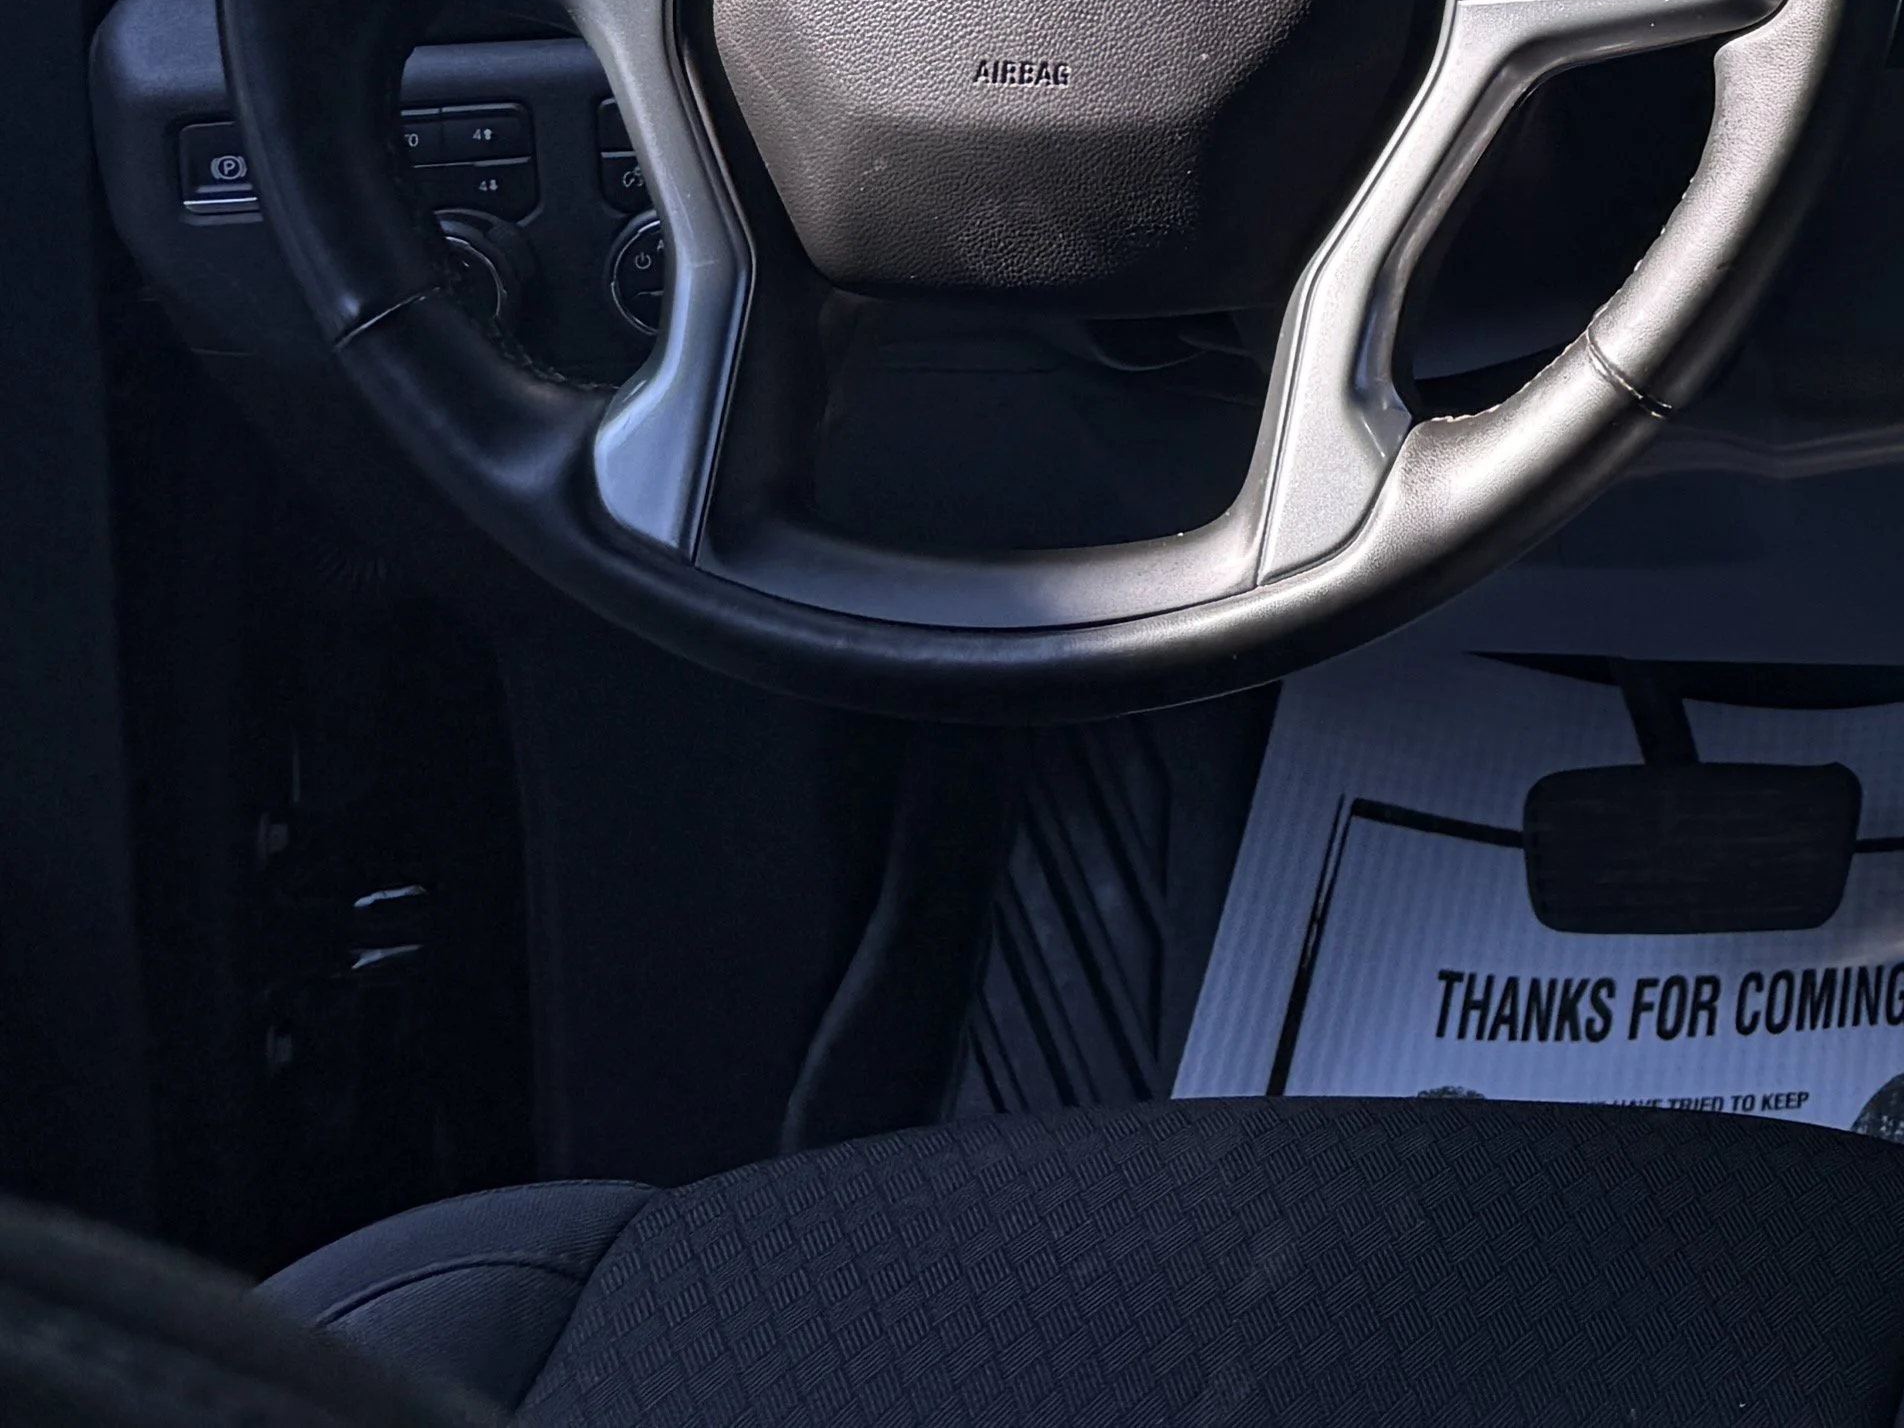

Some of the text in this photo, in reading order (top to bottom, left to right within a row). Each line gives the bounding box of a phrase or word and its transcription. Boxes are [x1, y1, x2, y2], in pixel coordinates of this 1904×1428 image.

[973, 60, 1071, 86] AIRBAG
[1434, 967, 1618, 1042] THANKS
[1627, 970, 1723, 1040] FOR
[1731, 1094, 1756, 1112] TO
[1760, 1091, 1810, 1112] KEEP
